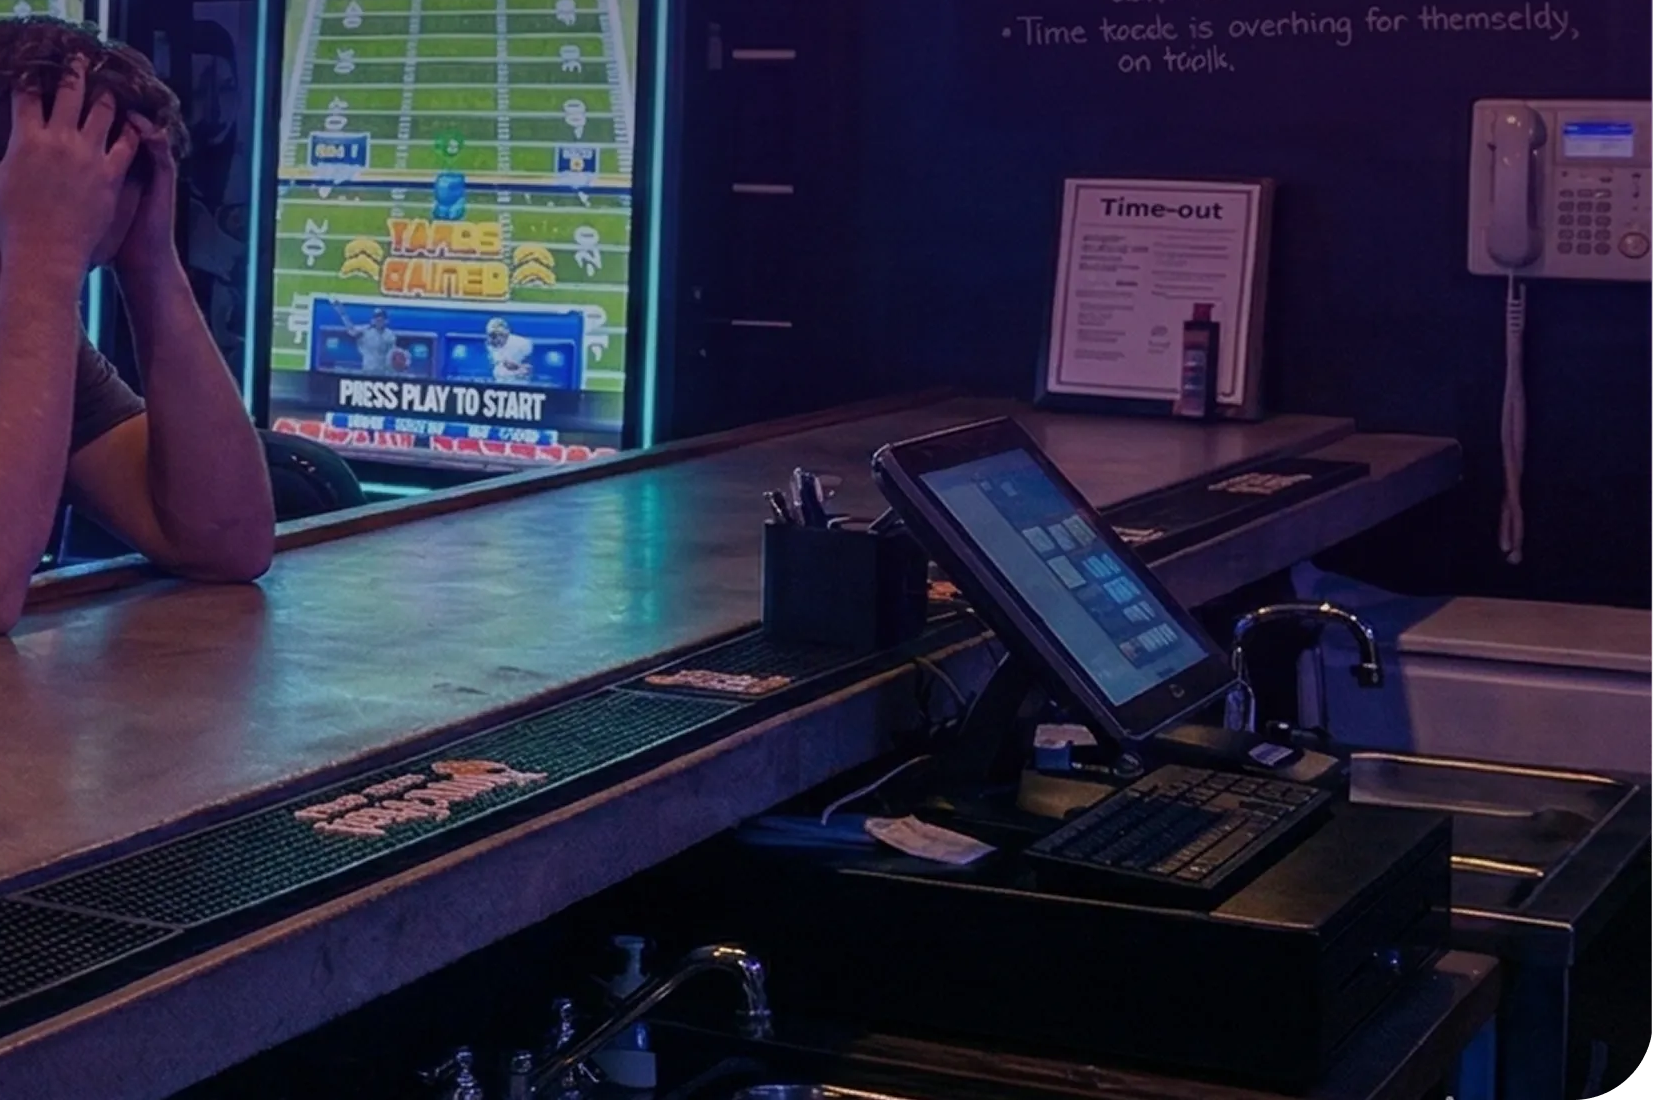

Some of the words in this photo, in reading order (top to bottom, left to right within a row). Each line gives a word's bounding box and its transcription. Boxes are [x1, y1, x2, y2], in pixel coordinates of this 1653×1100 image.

[1016, 16, 1088, 46] Time
[1189, 16, 1213, 39] is
[1366, 4, 1408, 33] for
[1118, 54, 1152, 73] on
[1100, 197, 1224, 220] Time-out
[339, 379, 399, 410] PRESS
[402, 384, 450, 415] PLAY
[453, 386, 481, 416] TO
[483, 389, 546, 421] START
